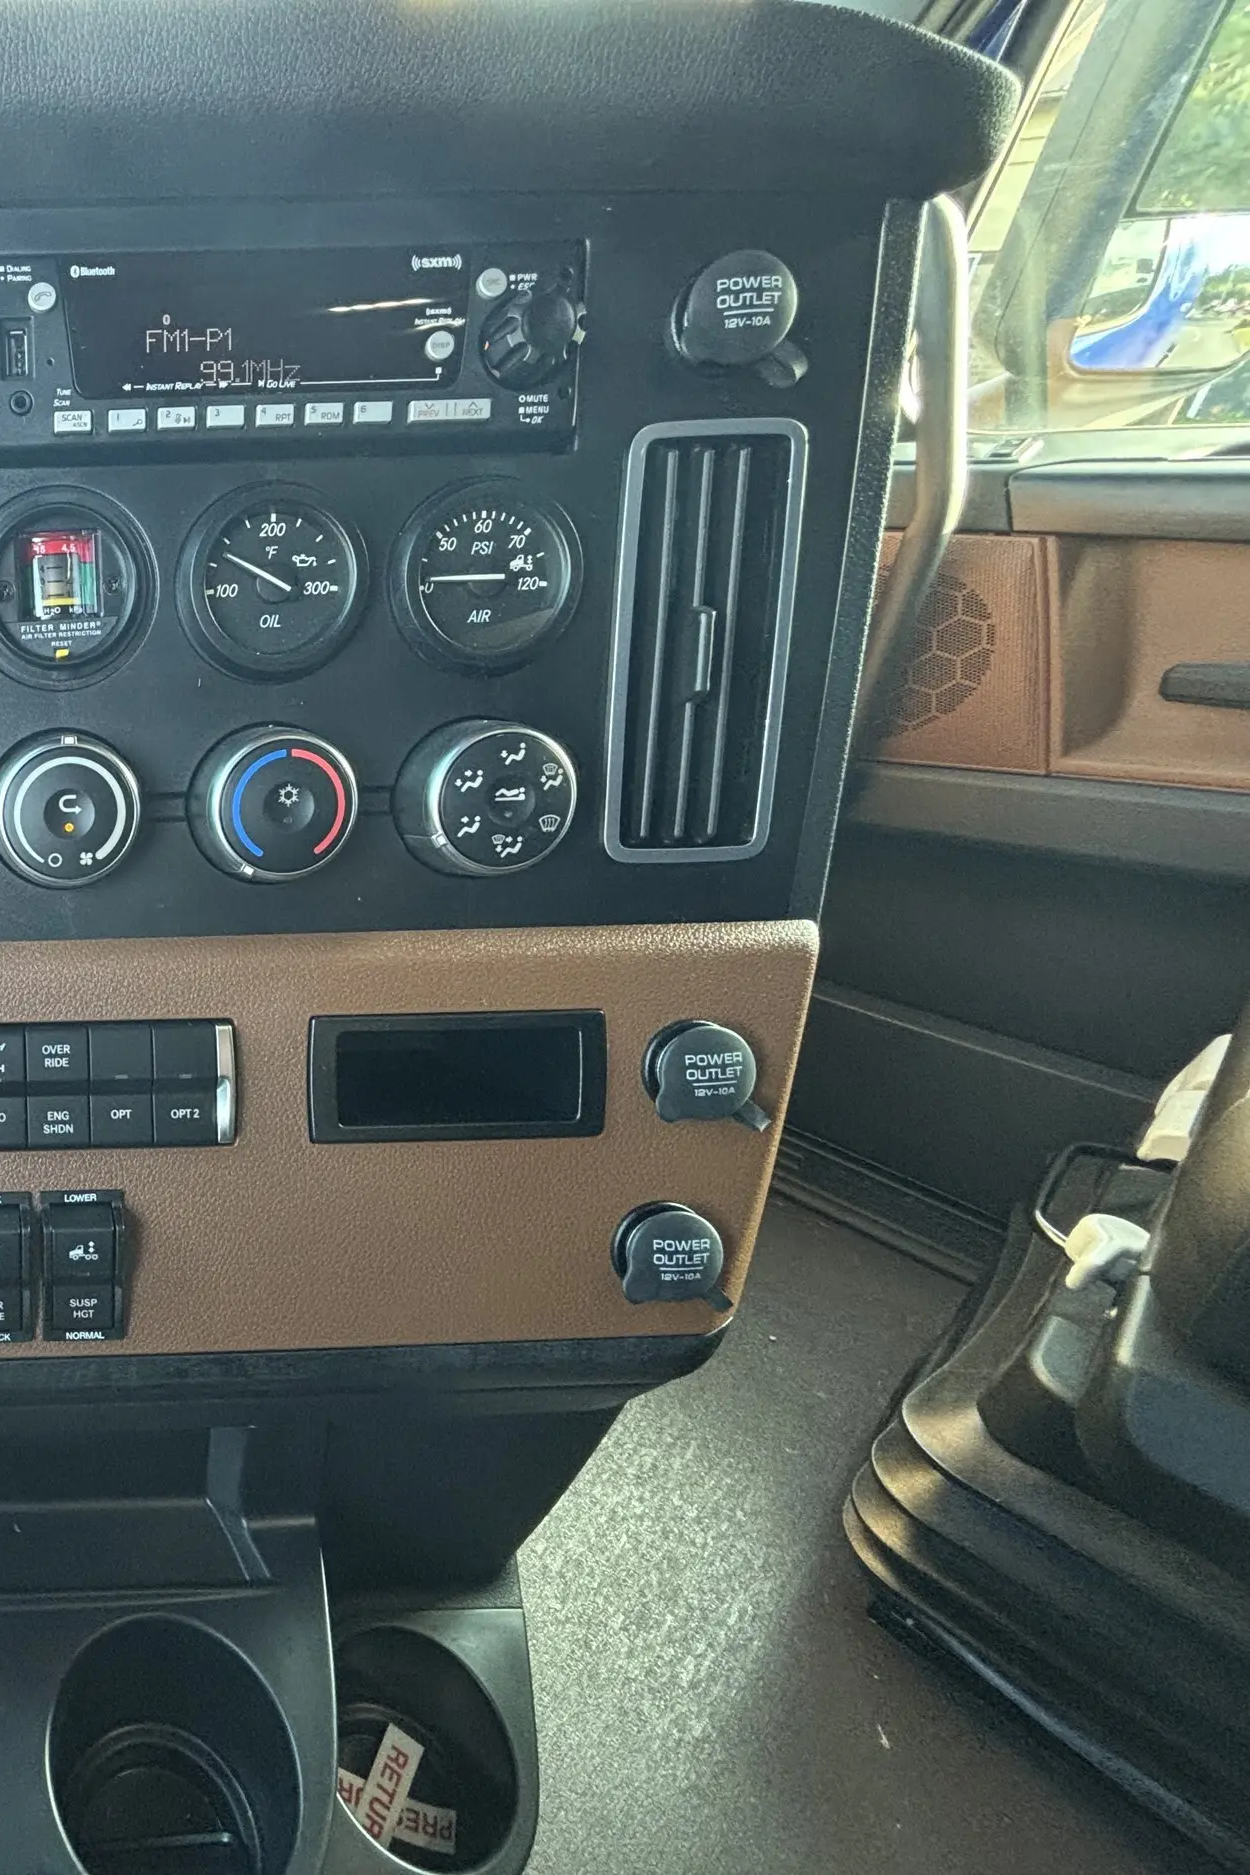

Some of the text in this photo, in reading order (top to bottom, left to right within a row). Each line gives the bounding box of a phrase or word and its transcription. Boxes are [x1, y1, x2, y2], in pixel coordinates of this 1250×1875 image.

[81, 266, 116, 277] Bluetooth
[517, 273, 538, 281] PWR
[716, 275, 783, 292] POWER
[716, 292, 782, 309] OUTLET
[724, 316, 771, 329] 12V-10A
[146, 328, 232, 353] FM1-P1
[200, 359, 301, 384] 99.1MHz
[146, 381, 203, 391] INSTANT REPLAY
[53, 399, 71, 407] SCAN
[526, 394, 549, 403] MUTE
[214, 408, 221, 417] 3
[260, 407, 267, 415] 4
[311, 405, 317, 414] 5
[360, 404, 367, 413] 6
[417, 409, 440, 418] PREV
[461, 407, 483, 416] NEXT
[525, 406, 550, 414] MENU
[61, 414, 83, 422] SCAN
[165, 410, 172, 419] 2
[275, 413, 292, 422] RPT
[320, 411, 340, 420] RDM
[531, 415, 544, 425] OK
[259, 523, 286, 537] 200
[474, 519, 493, 534] 60
[438, 537, 457, 551] 50
[508, 535, 526, 549] 70
[471, 541, 494, 555] PSI
[303, 580, 330, 596] 300
[517, 576, 539, 591] 120
[215, 583, 239, 598] 100
[259, 614, 282, 629] OIL
[467, 609, 492, 624] AIR
[20, 623, 54, 633] FILTER
[58, 629, 102, 638] RESTRICTION
[41, 1044, 71, 1056] OVER
[43, 1056, 70, 1069] RIDE
[684, 1052, 743, 1067] POWER
[686, 1066, 743, 1081] OUTLET
[693, 1086, 736, 1097] 12V-10A
[46, 1110, 70, 1122] ENG
[110, 1108, 132, 1120] OPT
[170, 1107, 200, 1120] OPT 2
[43, 1122, 75, 1135] SHDN
[63, 1193, 98, 1203] LOWER
[652, 1238, 711, 1252] POWER
[652, 1252, 711, 1266] OUTLET
[660, 1272, 702, 1282] 12V-10A
[68, 1298, 98, 1309] SUSP
[72, 1309, 95, 1319] HGT
[65, 1330, 105, 1341] NORMAL
